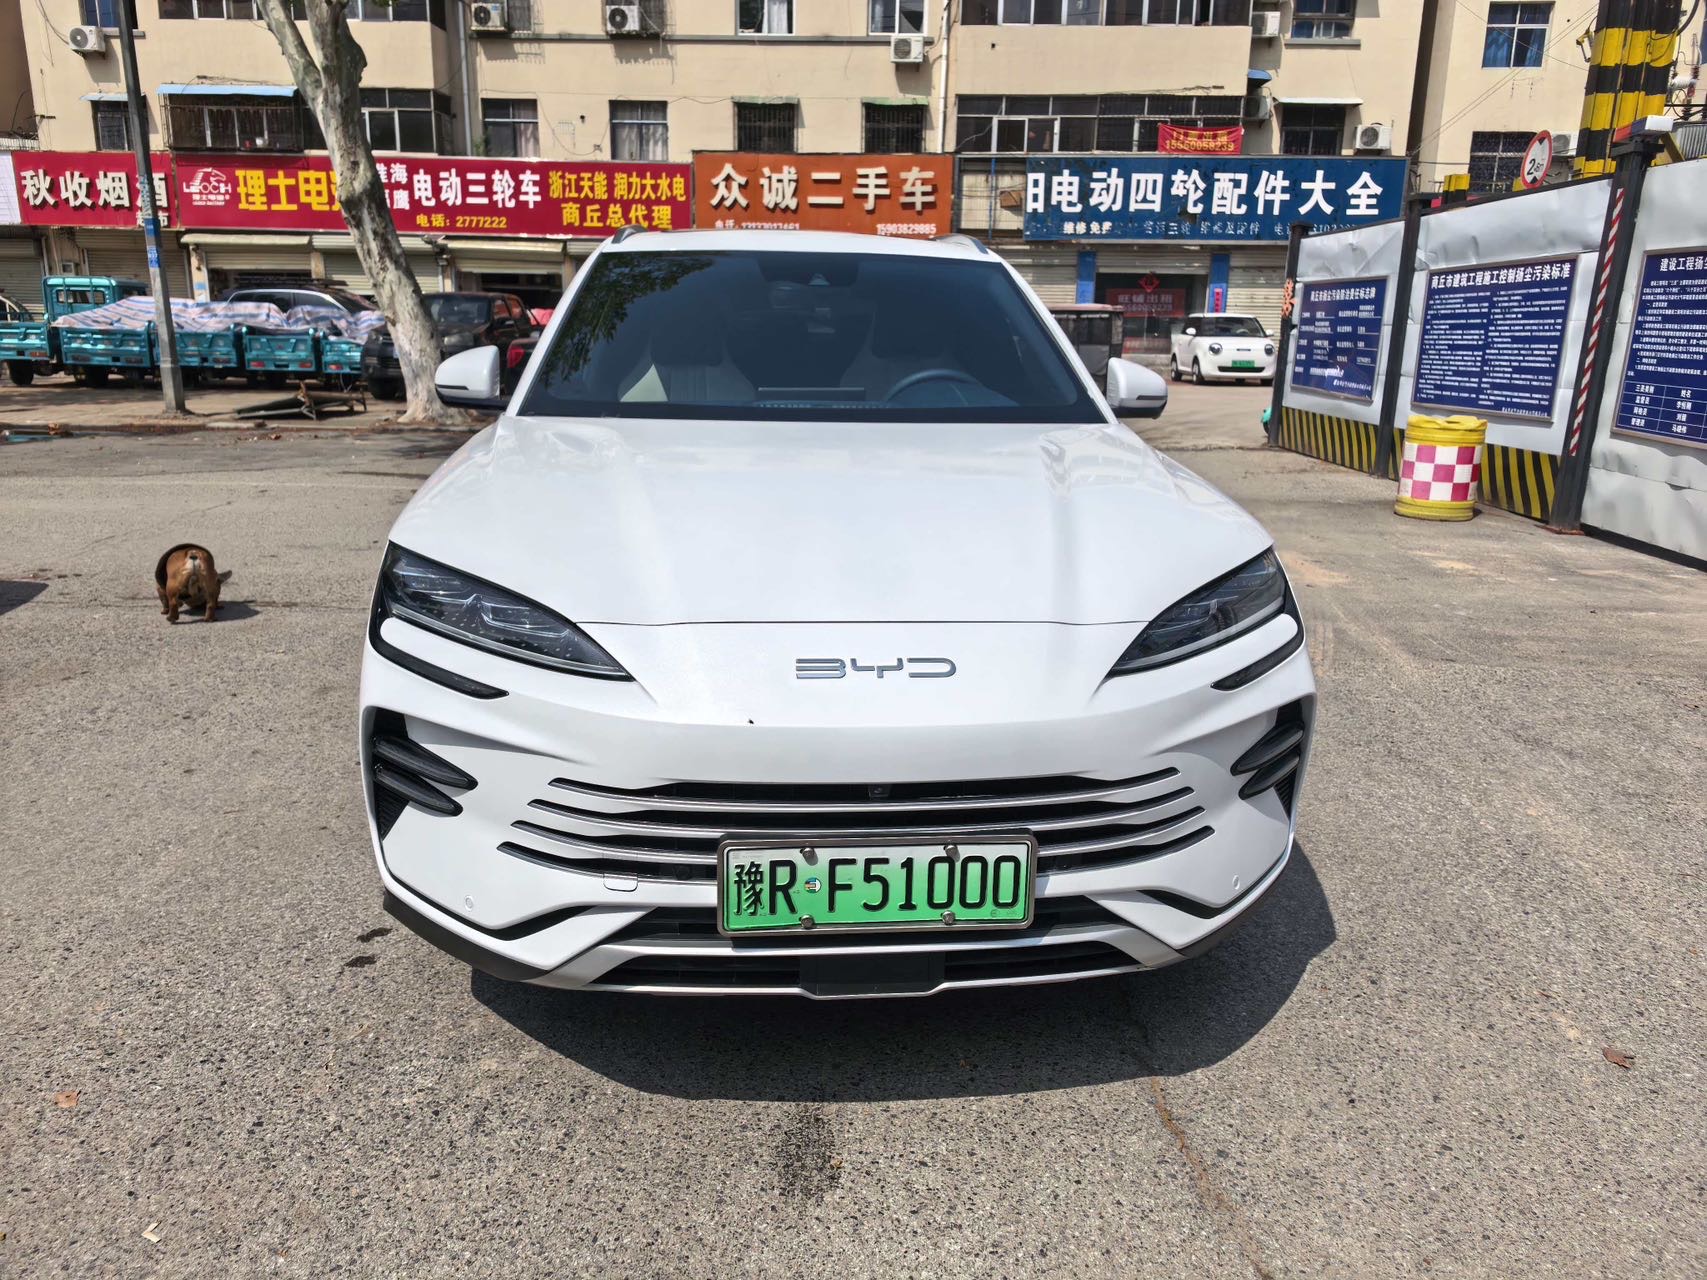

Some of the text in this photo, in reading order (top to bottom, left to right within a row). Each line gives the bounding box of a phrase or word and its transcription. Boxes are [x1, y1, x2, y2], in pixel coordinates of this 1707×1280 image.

[20, 169, 169, 208] 秋收烟酒
[235, 169, 340, 211] 理士电
[412, 168, 542, 209] 电动三轮车
[548, 170, 608, 200] 浙江天能
[710, 162, 936, 212] 众诚二手车
[455, 216, 508, 229] 2777222
[560, 203, 673, 228] 商丘总代理
[796, 657, 957, 679] BYD
[733, 855, 1021, 916] 豫R F51000
